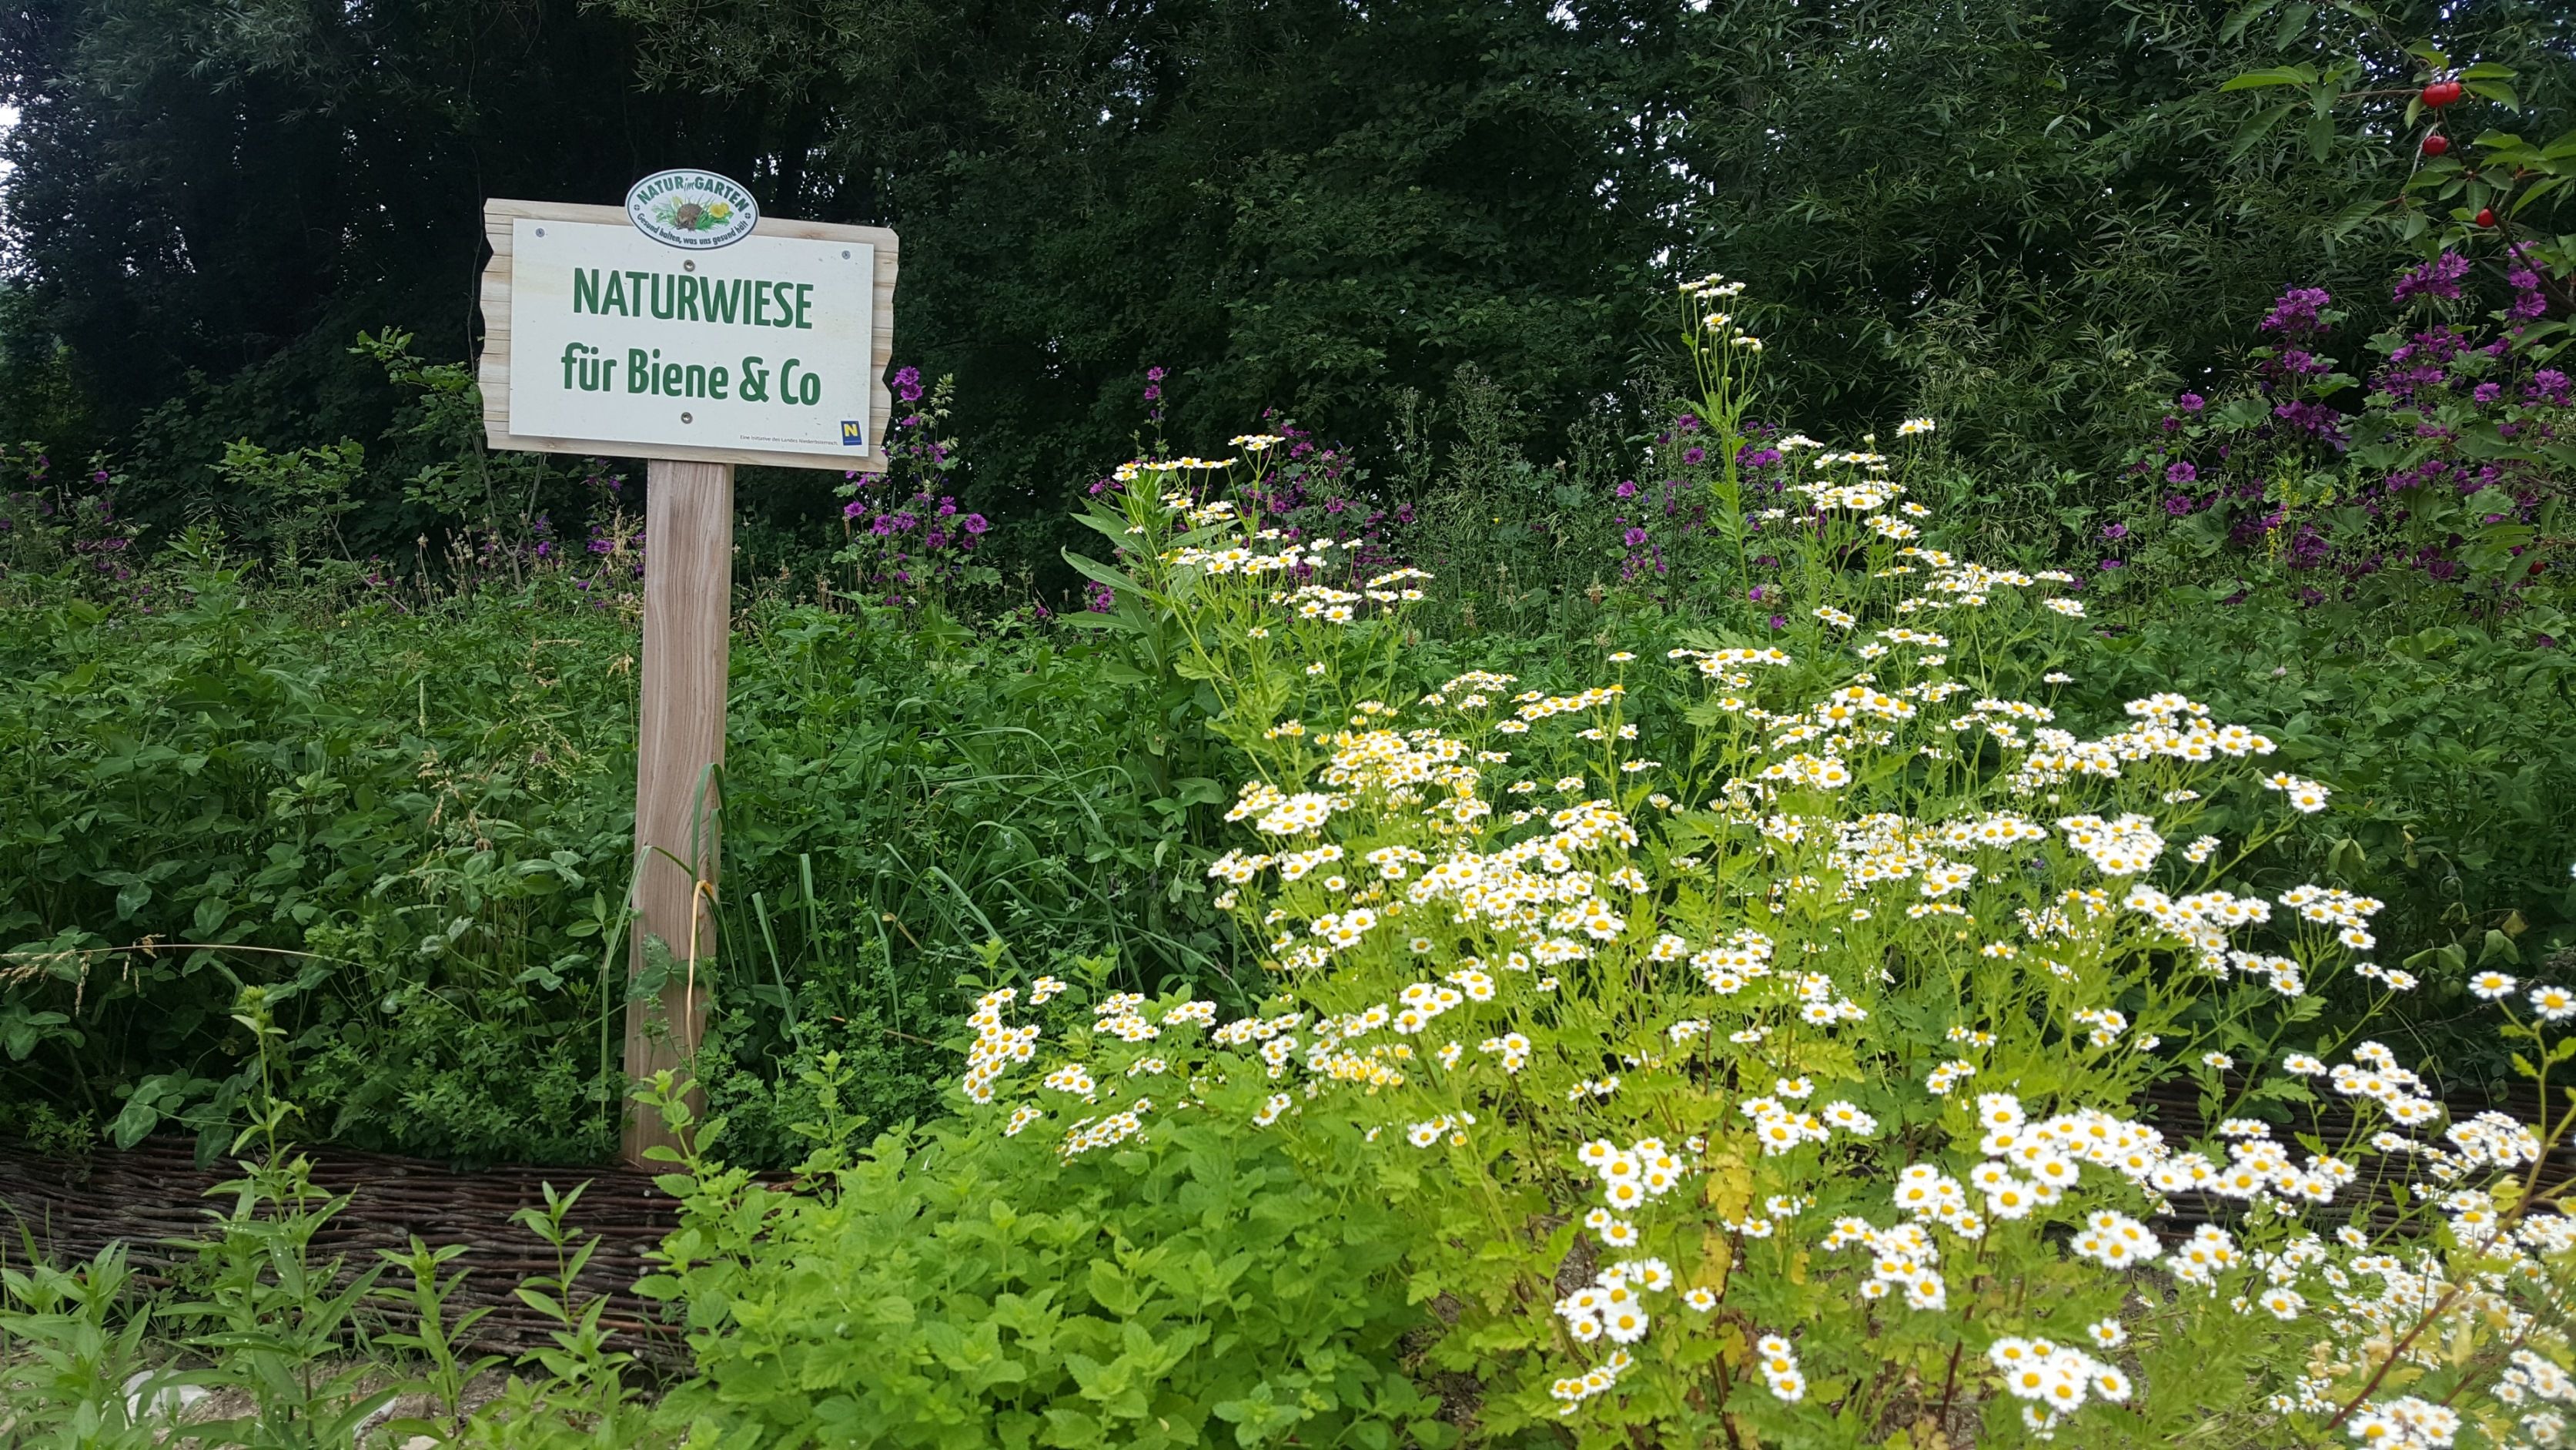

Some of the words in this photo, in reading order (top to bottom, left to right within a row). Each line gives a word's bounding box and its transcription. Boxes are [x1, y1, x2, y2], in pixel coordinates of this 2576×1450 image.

[637, 176, 684, 205] NATUR
[684, 179, 695, 193] im
[694, 176, 749, 213] GARTEN
[637, 213, 660, 234] Gesund
[659, 229, 682, 245] halten,
[683, 236, 698, 245] was
[713, 229, 736, 245] gesund
[734, 219, 749, 234] hält
[574, 267, 814, 329] NATURWIESE
[561, 342, 617, 391] für
[627, 348, 729, 400] Biene
[739, 356, 770, 403] &
[780, 358, 821, 406] Co
[844, 424, 858, 437] N
